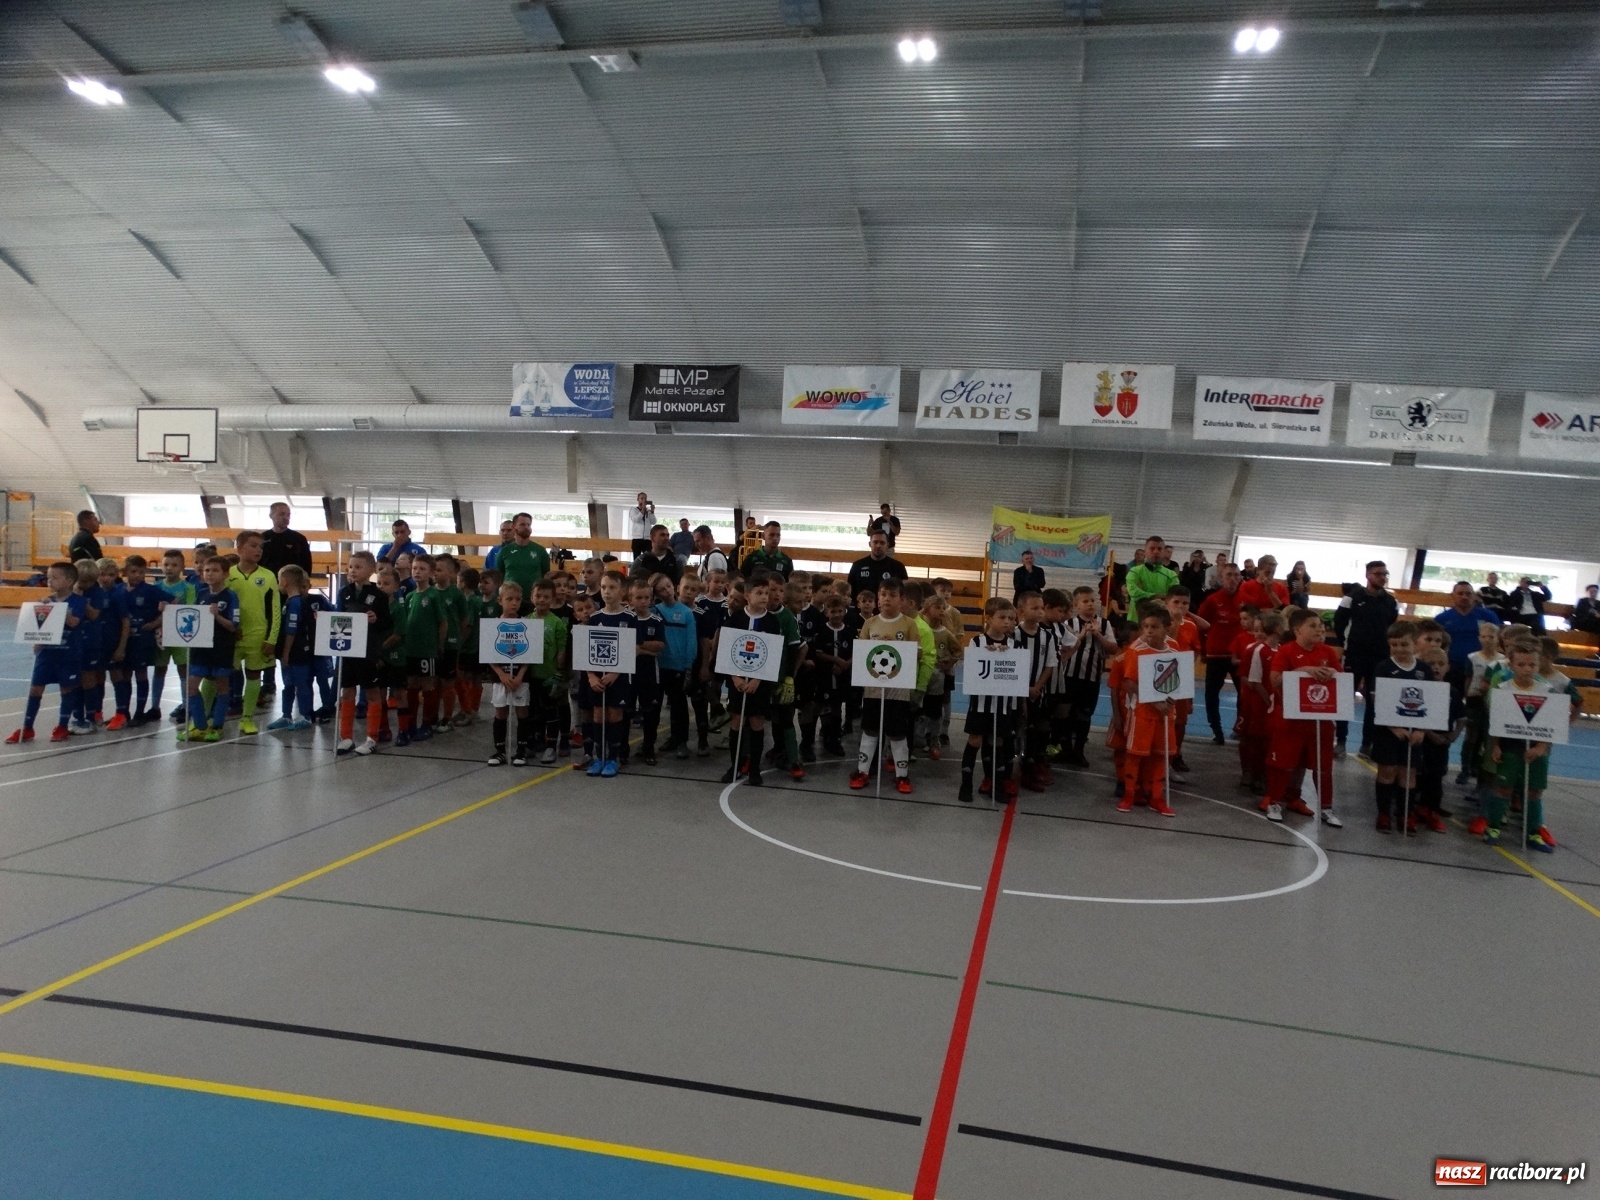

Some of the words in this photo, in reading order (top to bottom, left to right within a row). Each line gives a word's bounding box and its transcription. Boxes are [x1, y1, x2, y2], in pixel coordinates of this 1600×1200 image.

[573, 369, 610, 380] WODA
[676, 369, 709, 386] MP
[574, 386, 610, 394] LEPSZA
[645, 386, 680, 395] Marek
[683, 387, 725, 395] Pazera
[940, 380, 1013, 405] Hotel
[806, 390, 863, 404] WOWO
[1203, 388, 1325, 411] Intermarché
[663, 402, 726, 413] OKNOPLAST
[922, 405, 1033, 420] HADES
[1375, 409, 1397, 418] GAL
[1271, 423, 1308, 432] Sieradzka
[505, 632, 519, 640] MKS
[420, 659, 429, 673] 9
